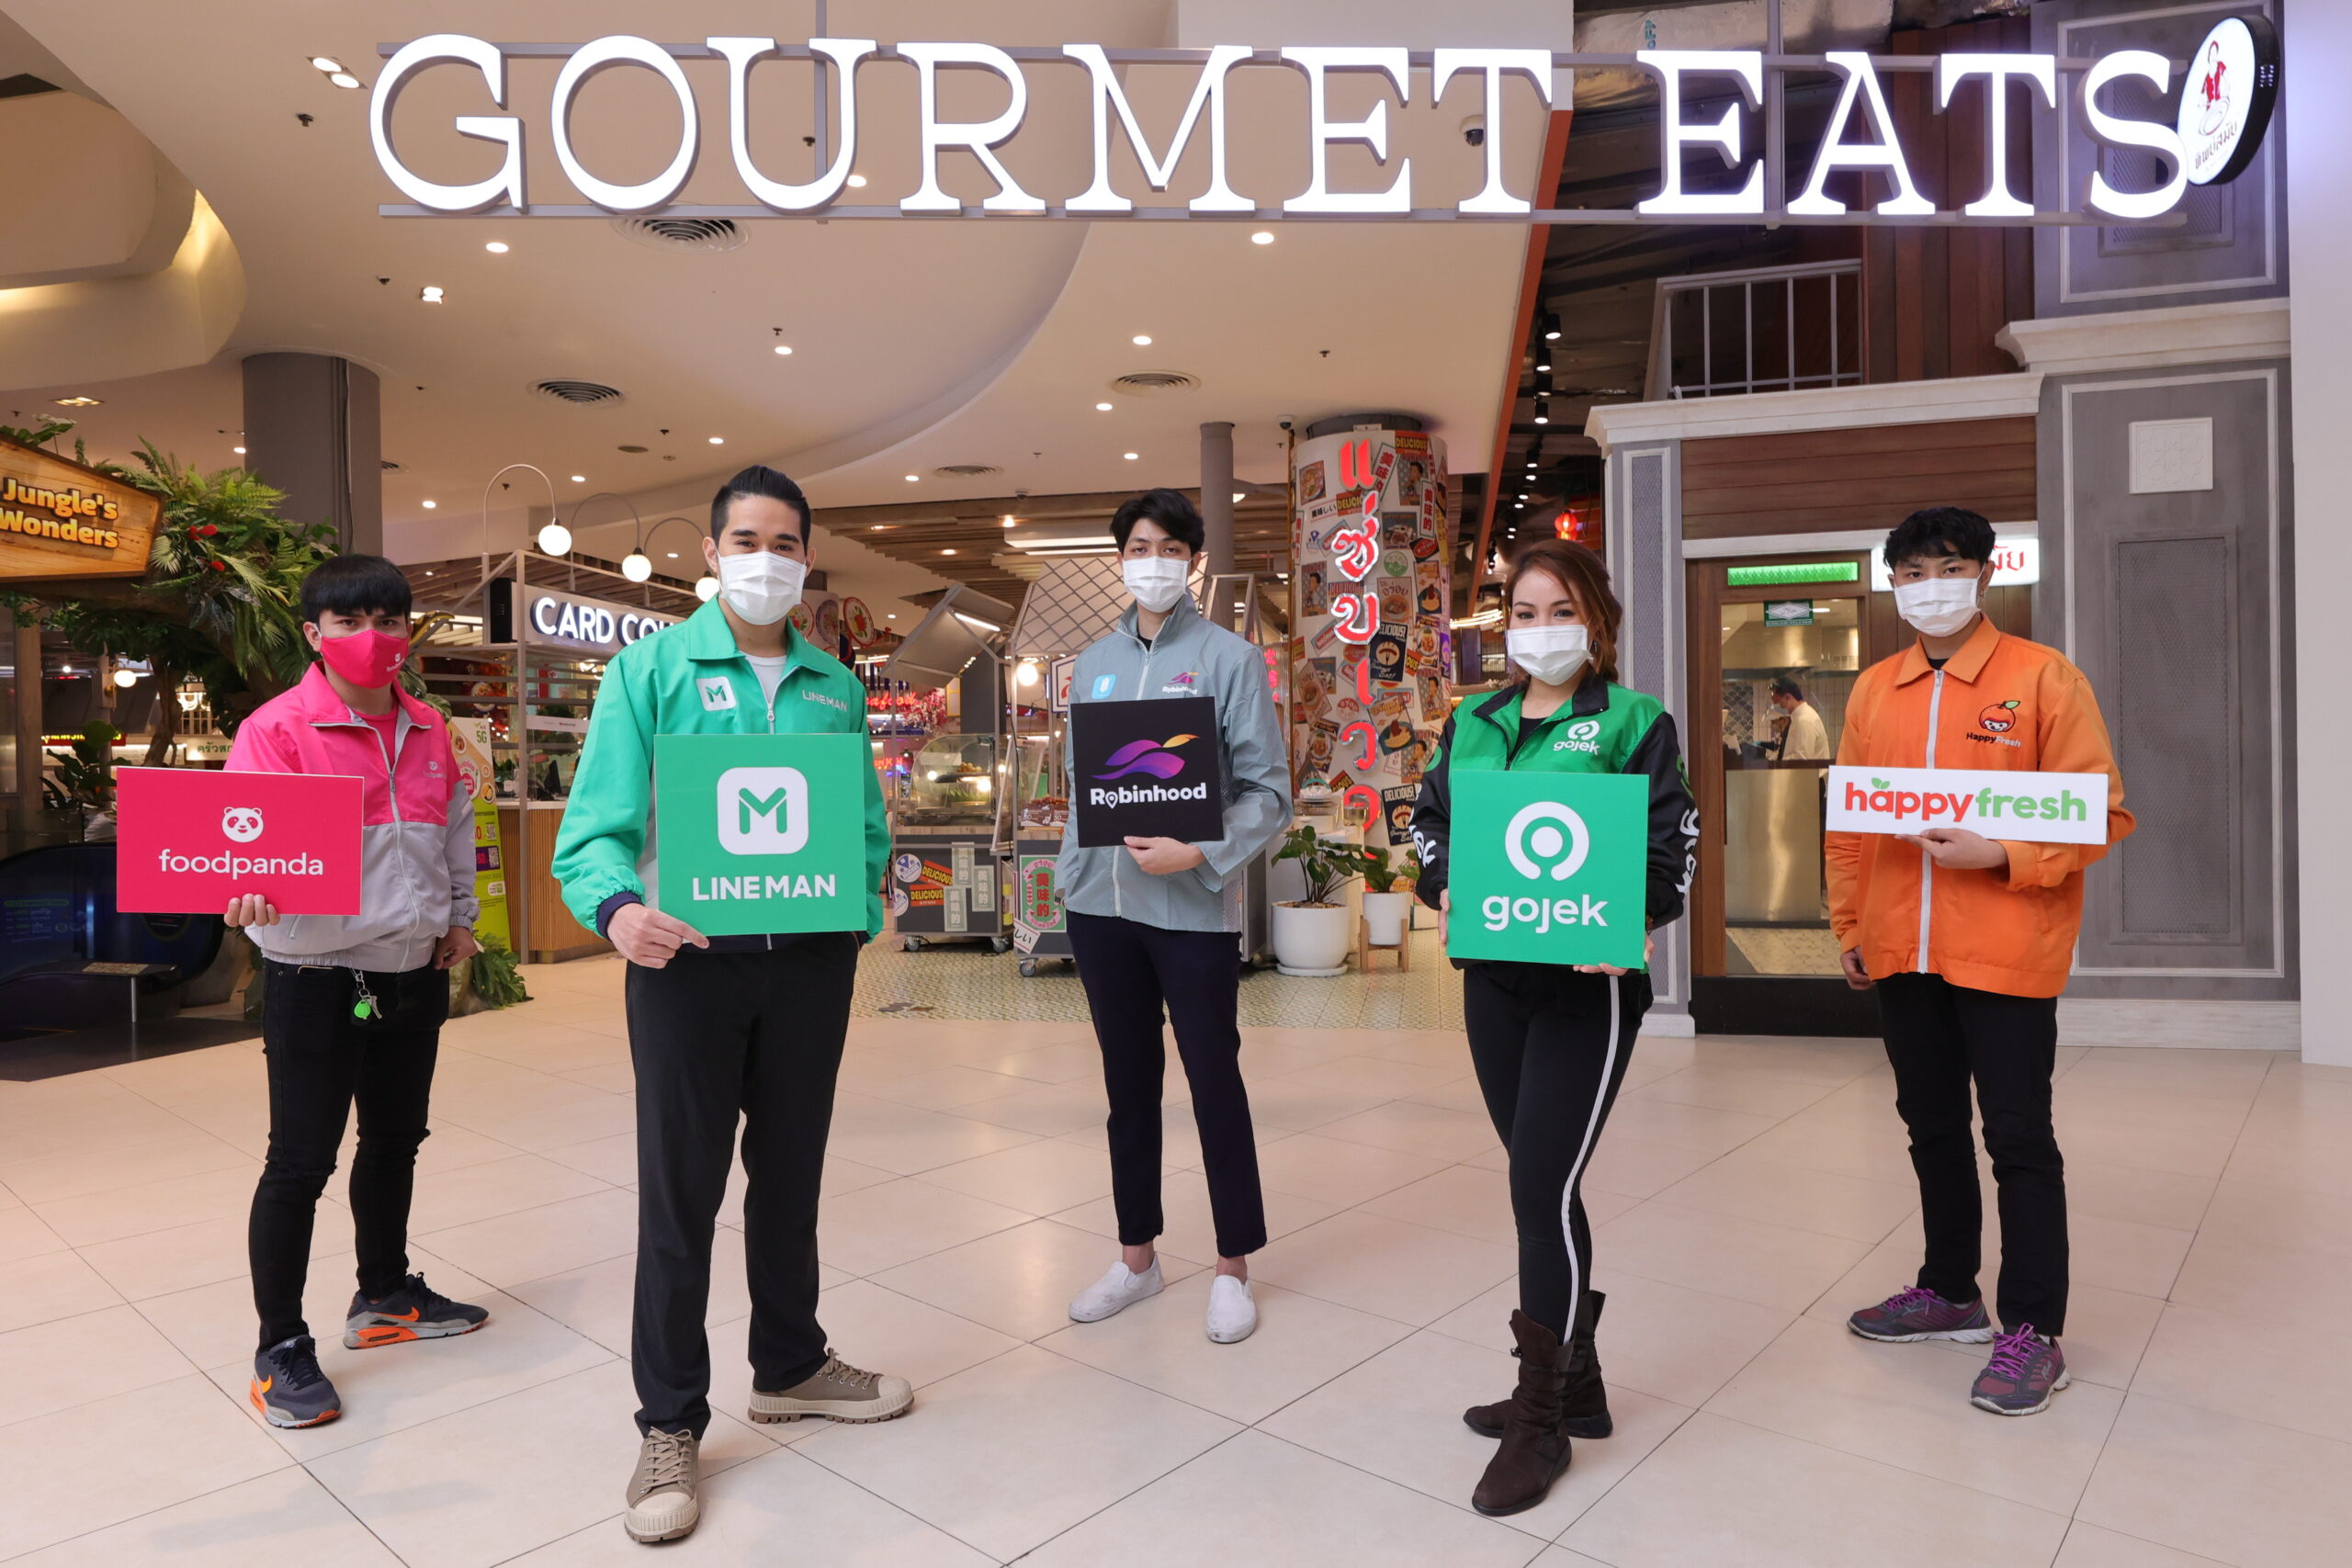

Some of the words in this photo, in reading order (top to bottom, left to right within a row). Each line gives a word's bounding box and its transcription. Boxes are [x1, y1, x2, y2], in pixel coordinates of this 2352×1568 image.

[369, 34, 1553, 213] GOURMET
[1636, 51, 2190, 219] EATS
[3, 477, 119, 521] Jungle's
[0, 507, 119, 549] Wonders
[532, 597, 615, 644] CARD
[476, 730, 488, 744] 5G
[1553, 740, 1601, 756] gojek
[1090, 782, 1207, 809] Robinhood
[158, 849, 324, 880] foodpanda
[910, 888, 944, 901] DELICIOUS
[1036, 872, 1050, 918] 美味的
[1482, 894, 1608, 935] gojek
